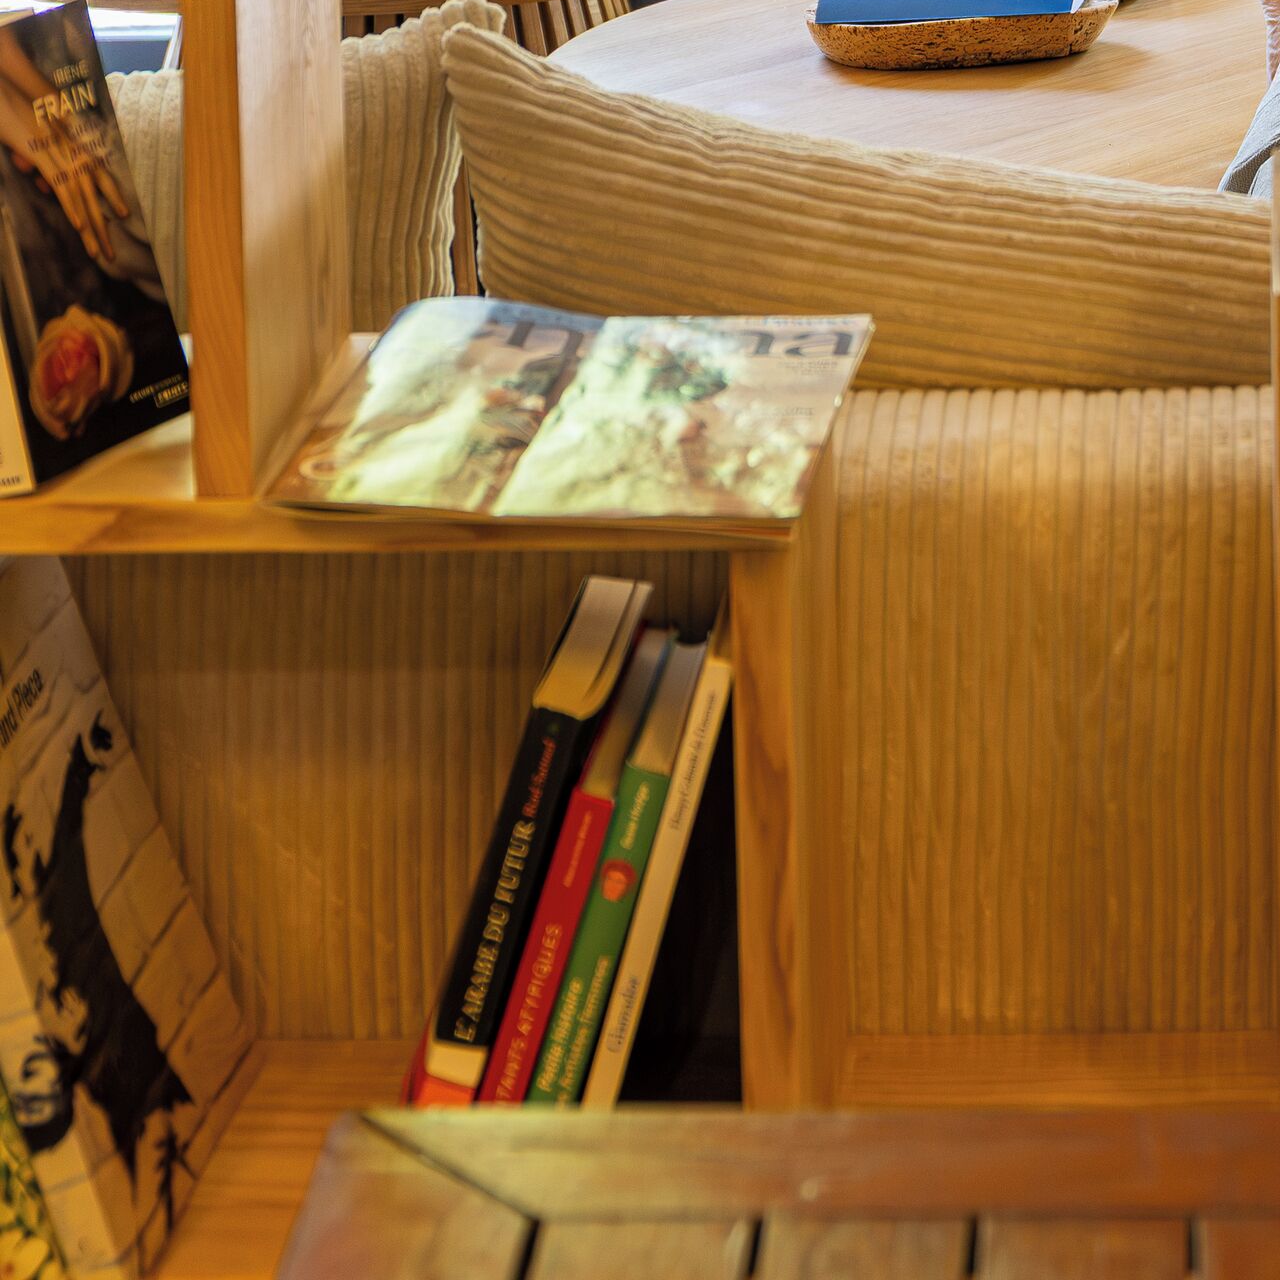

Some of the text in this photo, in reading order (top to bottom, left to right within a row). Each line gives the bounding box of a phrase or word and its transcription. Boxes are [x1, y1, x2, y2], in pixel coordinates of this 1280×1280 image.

[32, 80, 97, 128] FRAIN
[492, 817, 537, 905] FUTUR
[479, 902, 513, 944] DU
